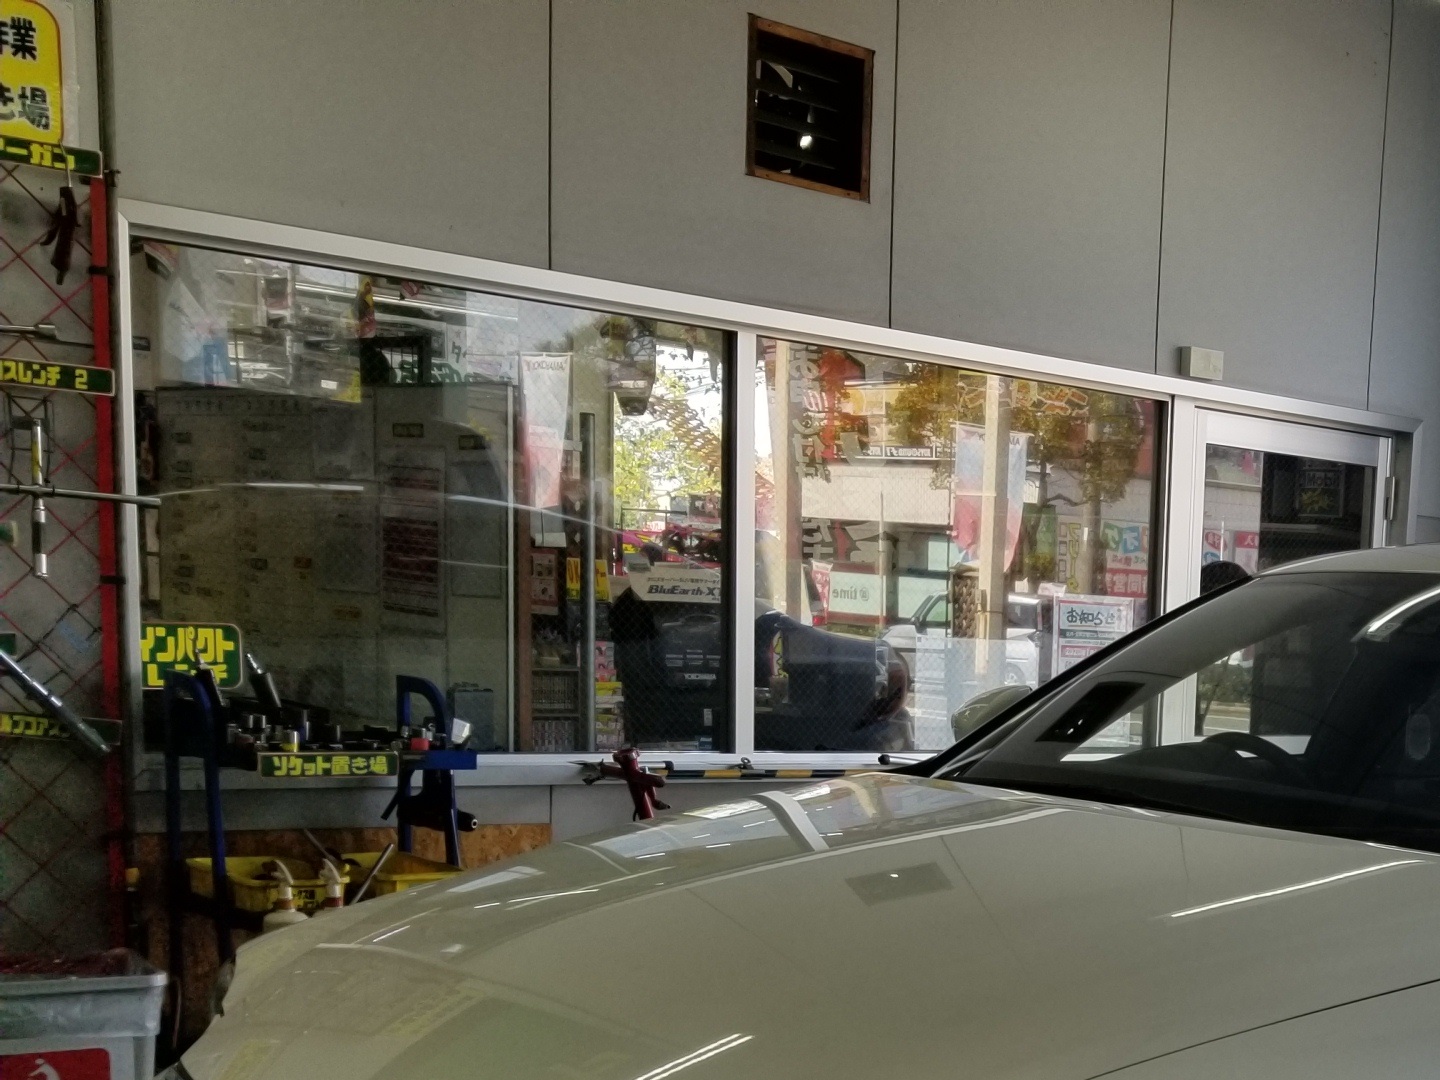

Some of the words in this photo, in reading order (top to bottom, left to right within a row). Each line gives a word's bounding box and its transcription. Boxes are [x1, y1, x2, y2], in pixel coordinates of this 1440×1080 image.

[0, 359, 61, 386] スレンチ
[74, 368, 88, 390] 2
[1066, 607, 1116, 625] お知らせ
[140, 626, 235, 663] インパクト
[272, 755, 388, 776] ソケット置き場
